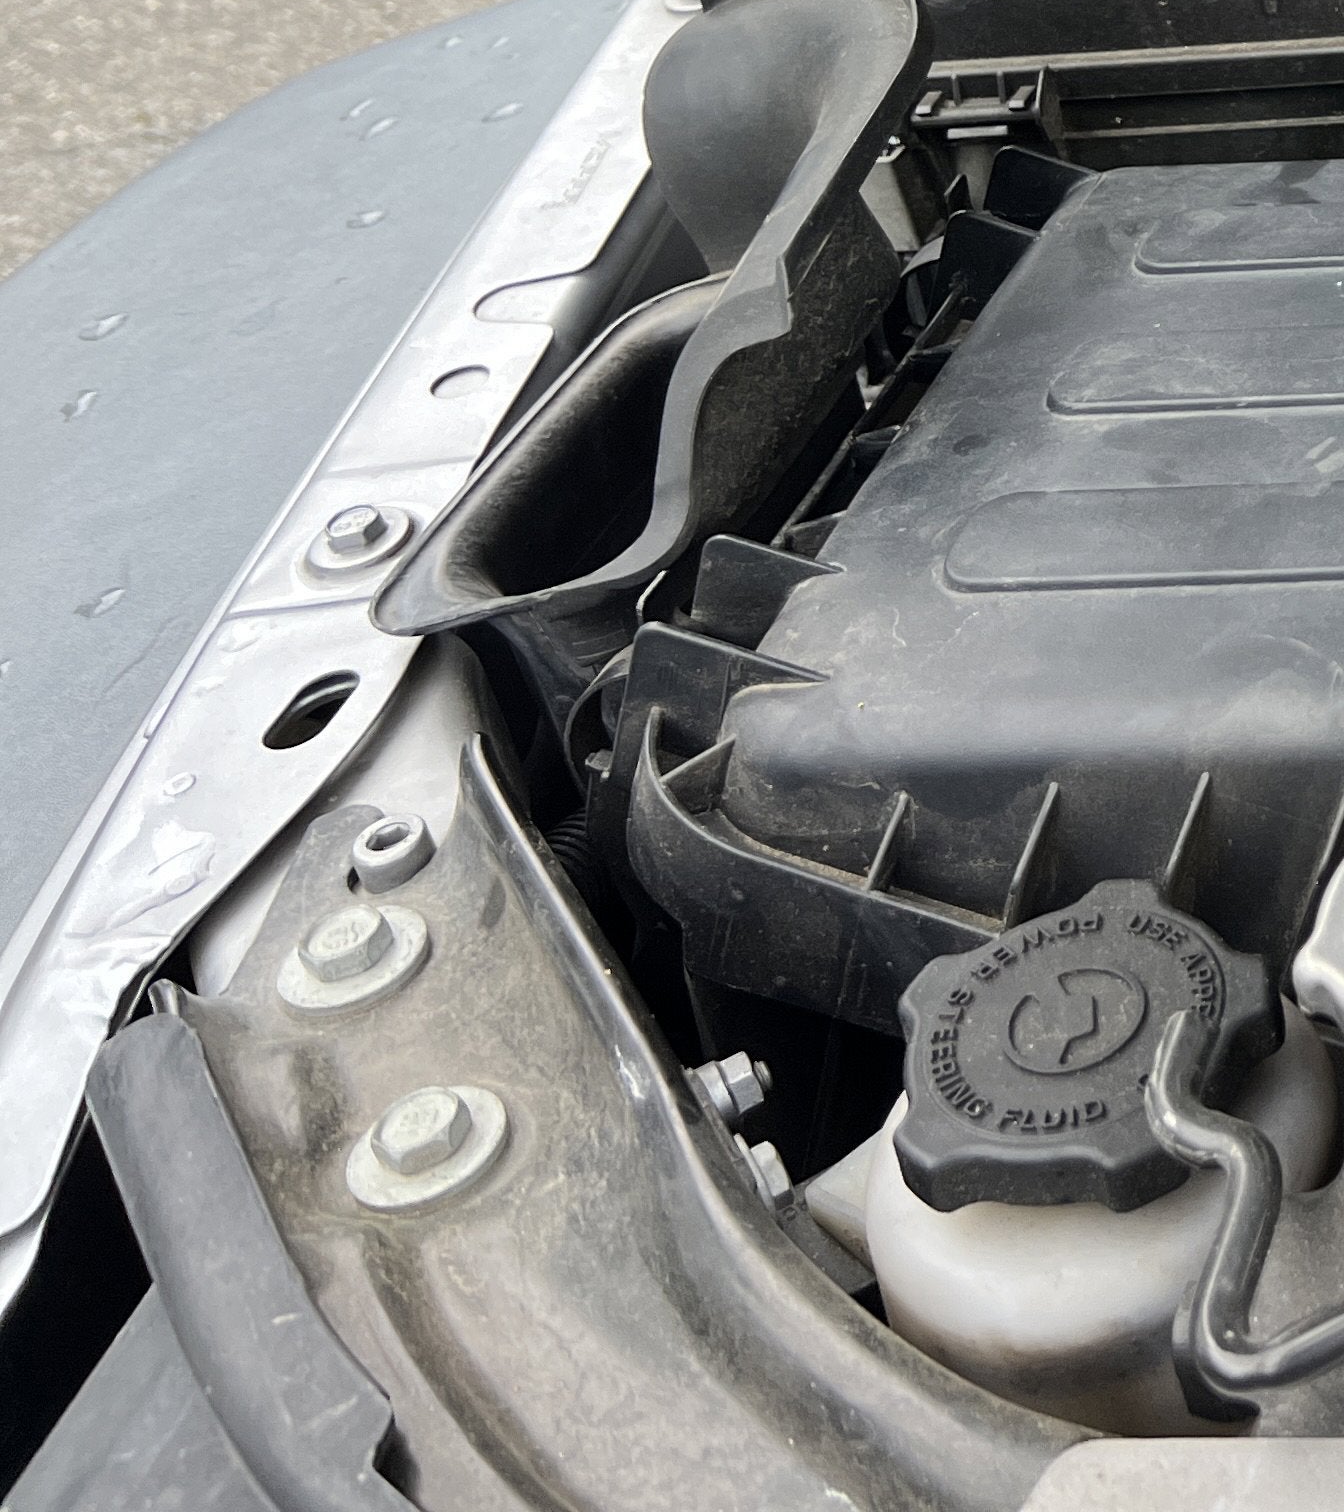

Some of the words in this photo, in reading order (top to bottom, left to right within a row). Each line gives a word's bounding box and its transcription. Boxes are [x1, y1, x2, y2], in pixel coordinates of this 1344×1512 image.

[970, 912, 1105, 982] POWER
[1128, 915, 1190, 952] USE
[930, 987, 993, 1118] STEERING
[998, 1100, 1108, 1136] FLUID
